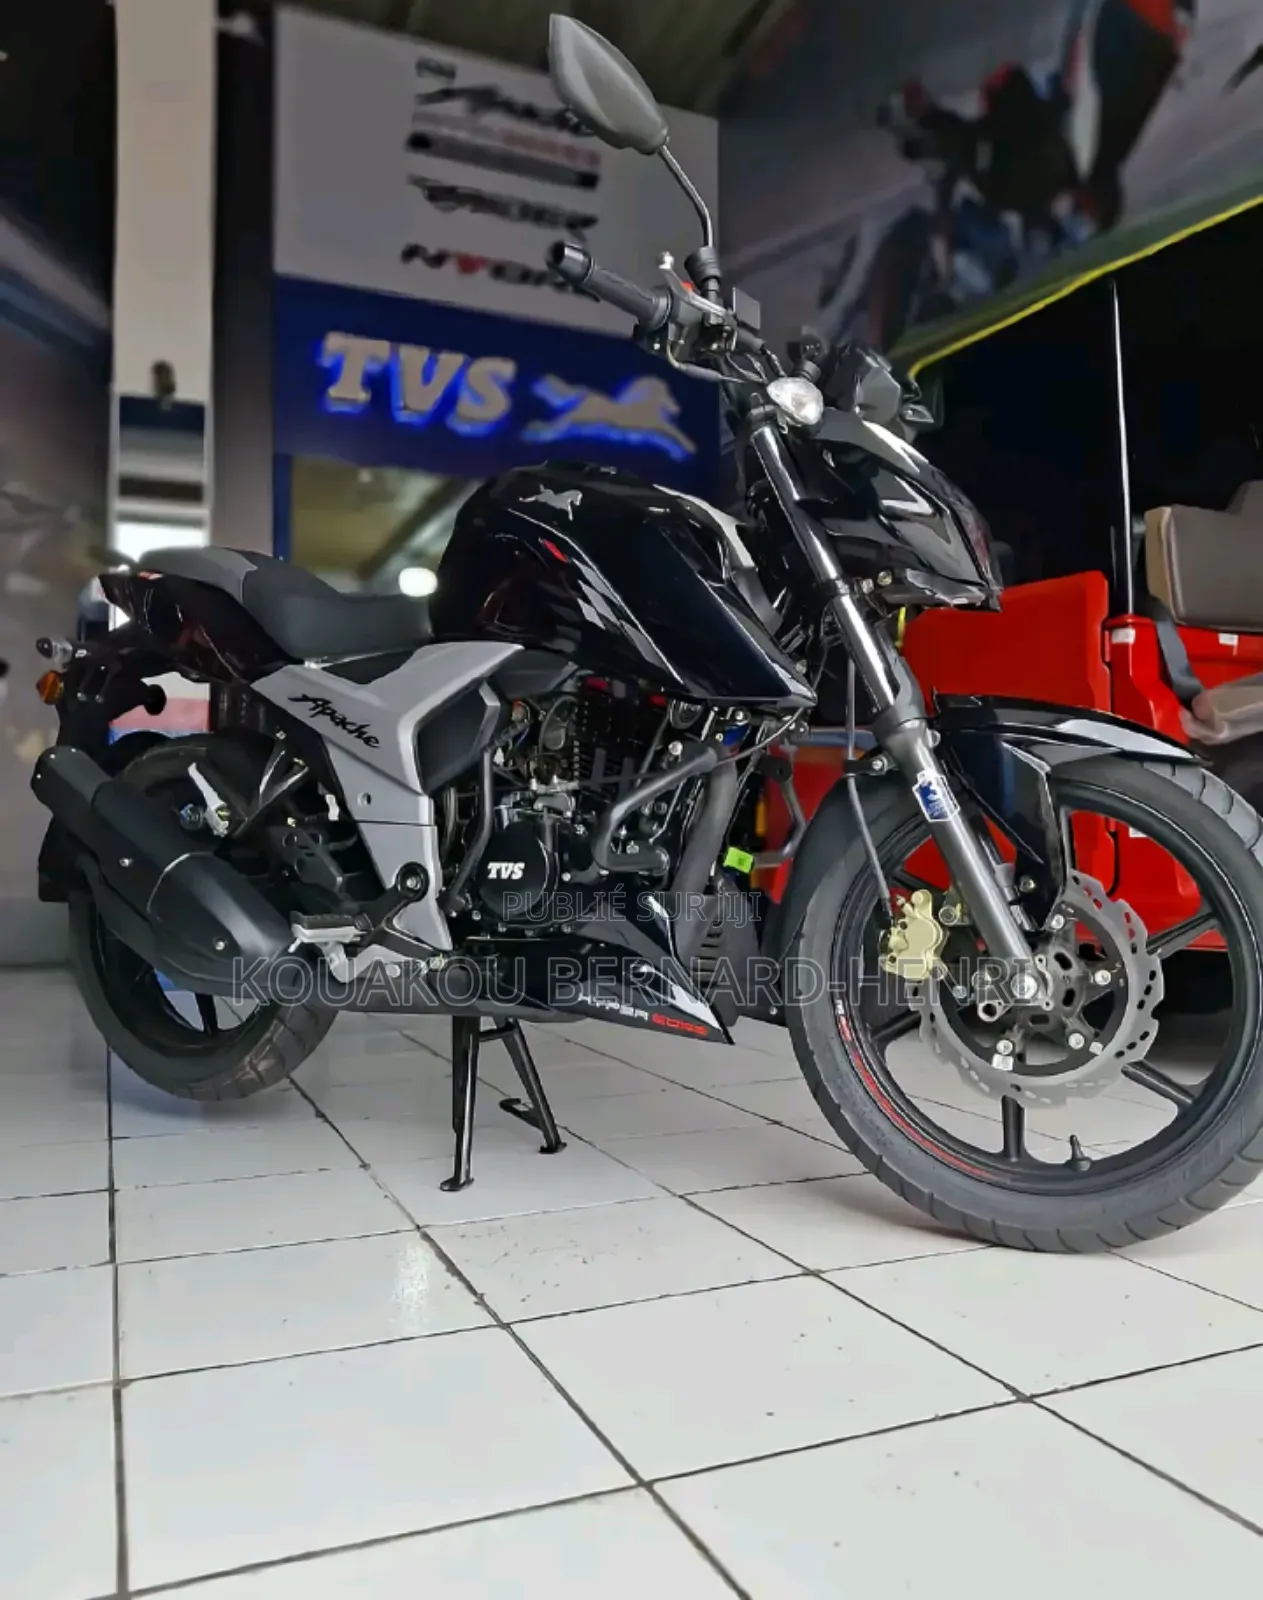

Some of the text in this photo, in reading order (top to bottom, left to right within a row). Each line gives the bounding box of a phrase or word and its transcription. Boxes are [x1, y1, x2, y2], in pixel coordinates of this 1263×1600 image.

[319, 331, 517, 432] TVS
[287, 693, 380, 749] Apache
[487, 861, 526, 880] TVS
